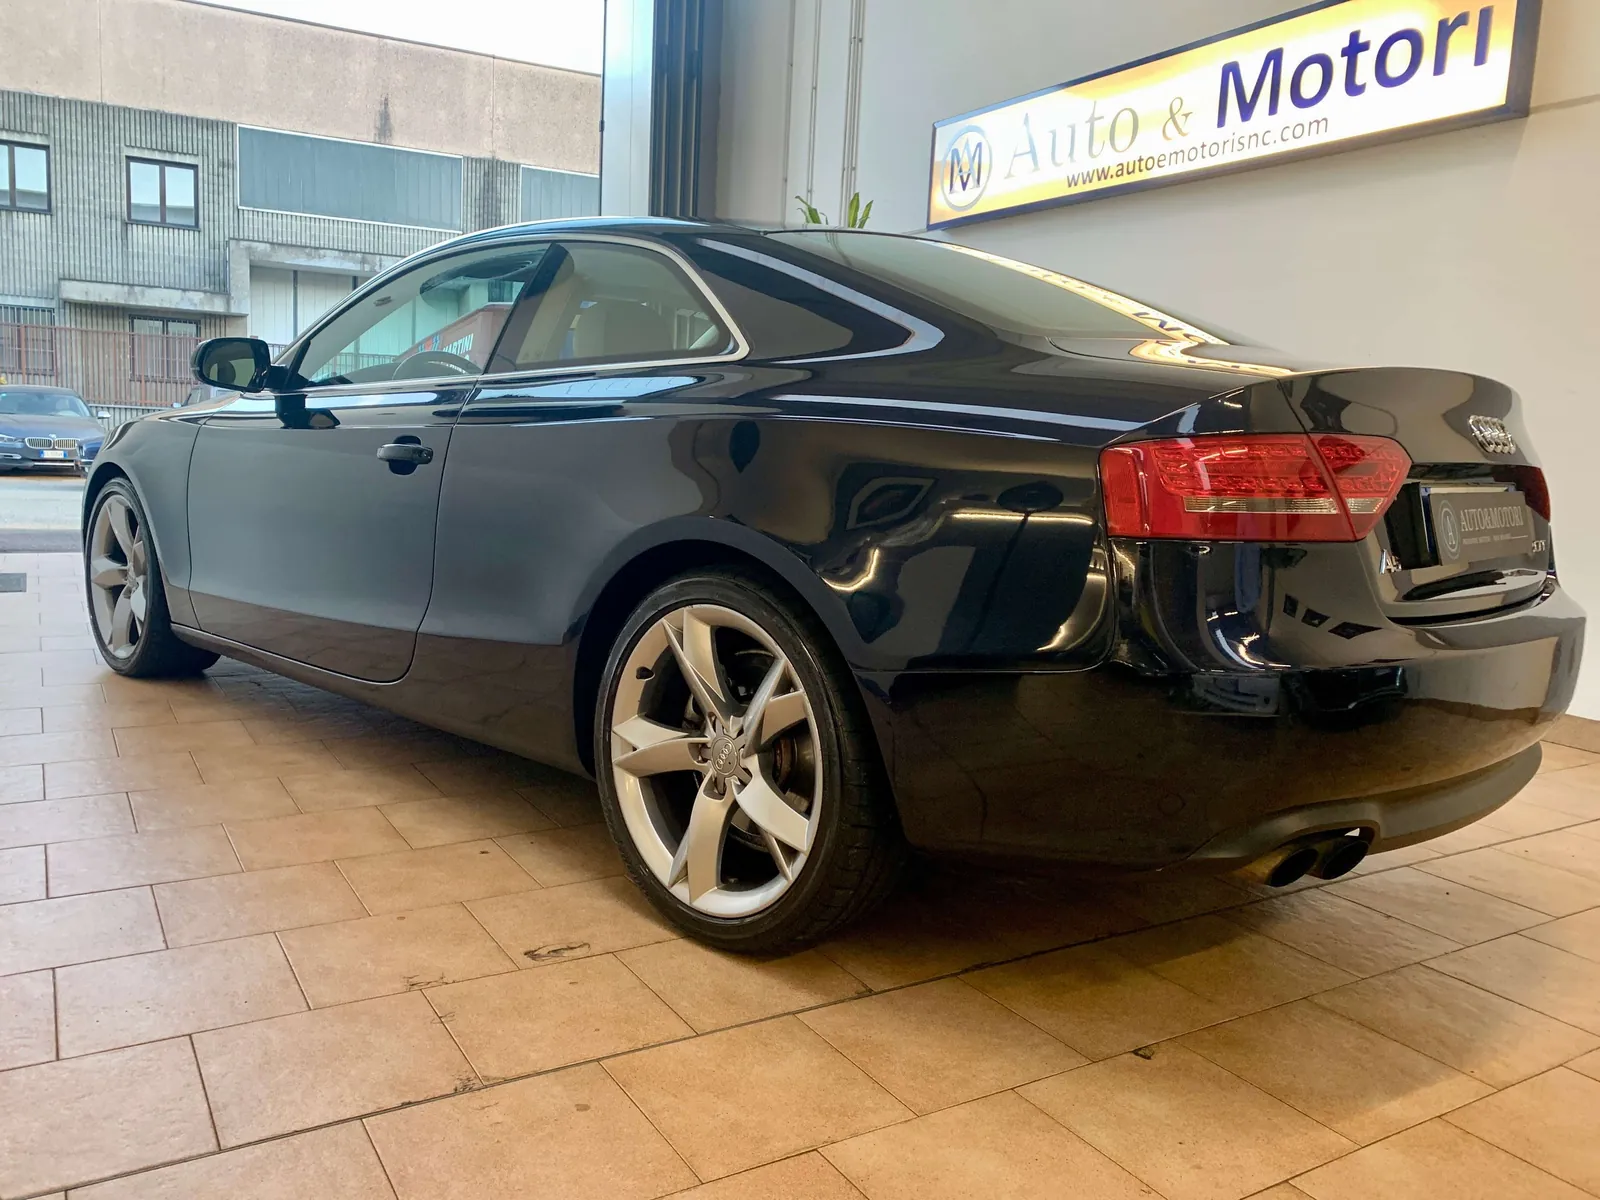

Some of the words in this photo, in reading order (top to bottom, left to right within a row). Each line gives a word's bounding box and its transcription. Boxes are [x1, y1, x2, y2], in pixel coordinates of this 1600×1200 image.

[1003, 100, 1140, 180] Auto
[1162, 96, 1193, 141] &
[1216, 5, 1494, 128] Motori
[1066, 117, 1329, 188] www.autoemotorisnc.com
